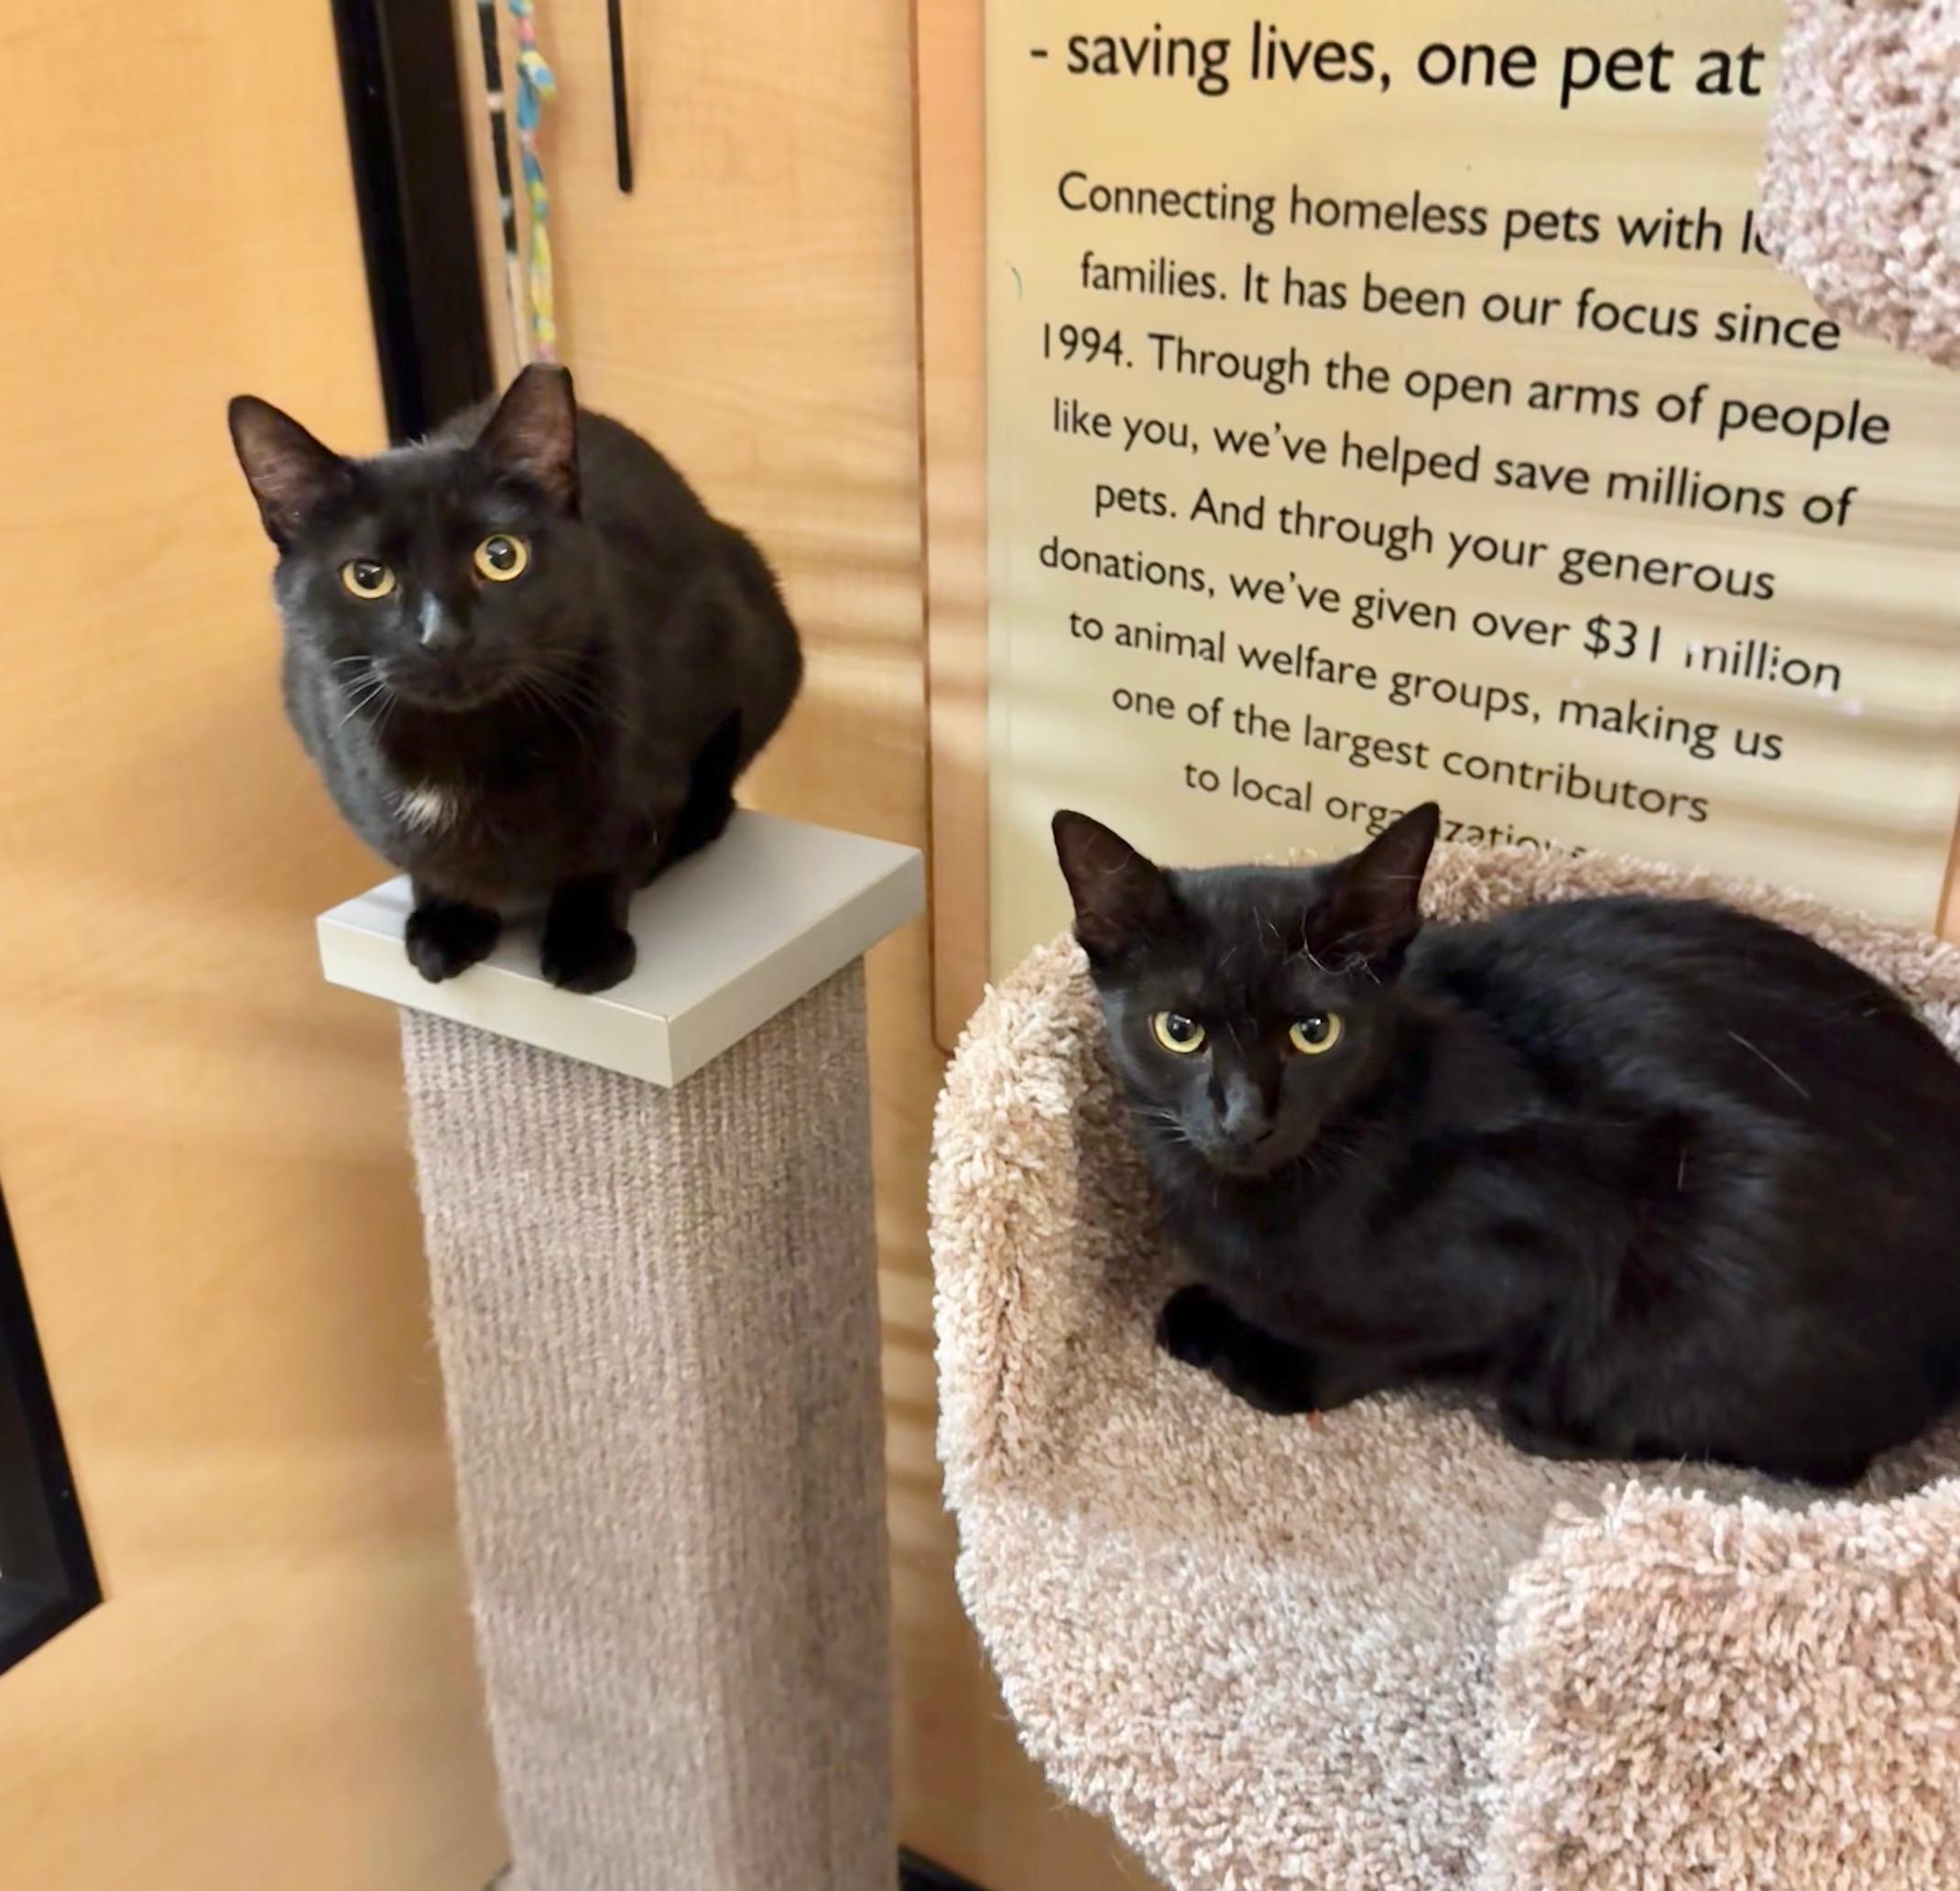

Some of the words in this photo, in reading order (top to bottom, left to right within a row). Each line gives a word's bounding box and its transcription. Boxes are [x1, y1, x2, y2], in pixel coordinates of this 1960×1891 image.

[1066, 22, 1232, 98] saving
[1250, 18, 1391, 93] lives,
[1417, 42, 1538, 89] one
[1559, 40, 1675, 111] pet
[1694, 41, 1767, 98] at
[1057, 169, 1277, 236] Connecting
[1290, 182, 1488, 237] homeless
[1502, 207, 1601, 252] pets
[1617, 205, 1724, 253] with
[1080, 250, 1226, 300] families.
[1244, 262, 1270, 305] It
[1283, 265, 1347, 310] has
[1362, 270, 1466, 321] been
[1481, 293, 1563, 327] our
[1576, 286, 1699, 340] focus
[1714, 302, 1841, 351] since
[1043, 322, 1134, 368] 1994.
[1147, 331, 1311, 396] Through
[1324, 351, 1390, 395] the
[1404, 369, 1512, 412] open
[1527, 380, 1640, 419] arms
[1655, 382, 1710, 426] of
[1717, 397, 1891, 452] people
[1053, 397, 1112, 439] like
[1123, 416, 1199, 455] you,
[1213, 421, 1328, 465] we've
[1341, 429, 1481, 487] helped
[1494, 459, 1591, 495] save
[1606, 464, 1786, 520] millions
[1802, 485, 1859, 528] of
[1039, 535, 1215, 599] donations,
[1228, 571, 1341, 614] we've
[1351, 587, 1457, 632] given
[1472, 611, 1572, 648] over
[1583, 613, 1661, 664] $31
[1094, 484, 1177, 519] pets.
[1189, 486, 1266, 531] And
[1279, 499, 1433, 562] through
[1446, 531, 1549, 570] your
[1557, 547, 1776, 602] generous
[1069, 612, 1105, 642] to
[1114, 621, 1225, 664] animal
[1237, 643, 1377, 690] welfare
[1388, 671, 1541, 724] groups,
[1558, 697, 1720, 761] making
[1734, 728, 1784, 761] us
[1112, 688, 1176, 720] one
[1187, 696, 1225, 729] of
[1233, 702, 1291, 743] the
[1304, 713, 1430, 770] largest
[1442, 751, 1709, 823] contributors
[1184, 763, 1221, 793] to
[1232, 766, 1312, 813] local
